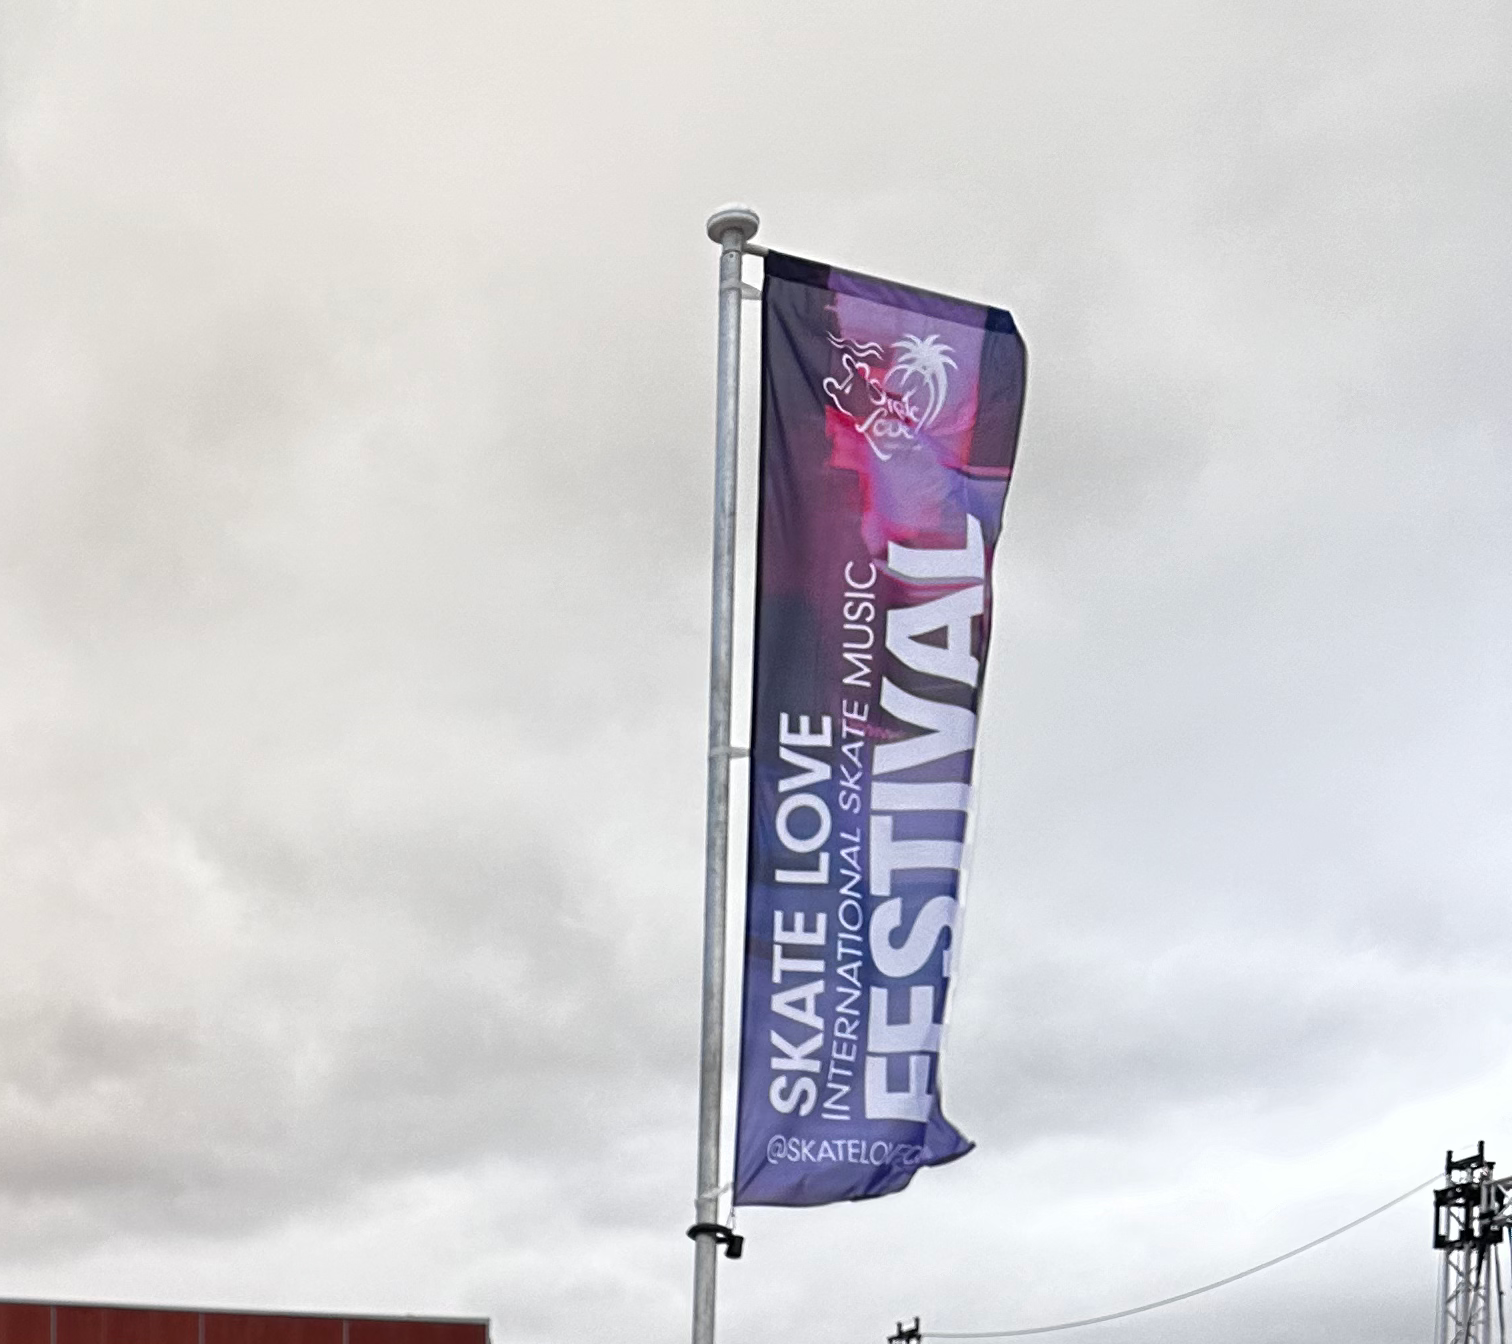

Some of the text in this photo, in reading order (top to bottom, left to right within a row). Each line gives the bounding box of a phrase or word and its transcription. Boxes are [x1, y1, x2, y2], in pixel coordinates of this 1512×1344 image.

[769, 712, 833, 1117] SKATE LOVE
[821, 560, 878, 1121] INTERNATIONAL SKATE MUSIC
[864, 512, 986, 1123] FESTIVAL
